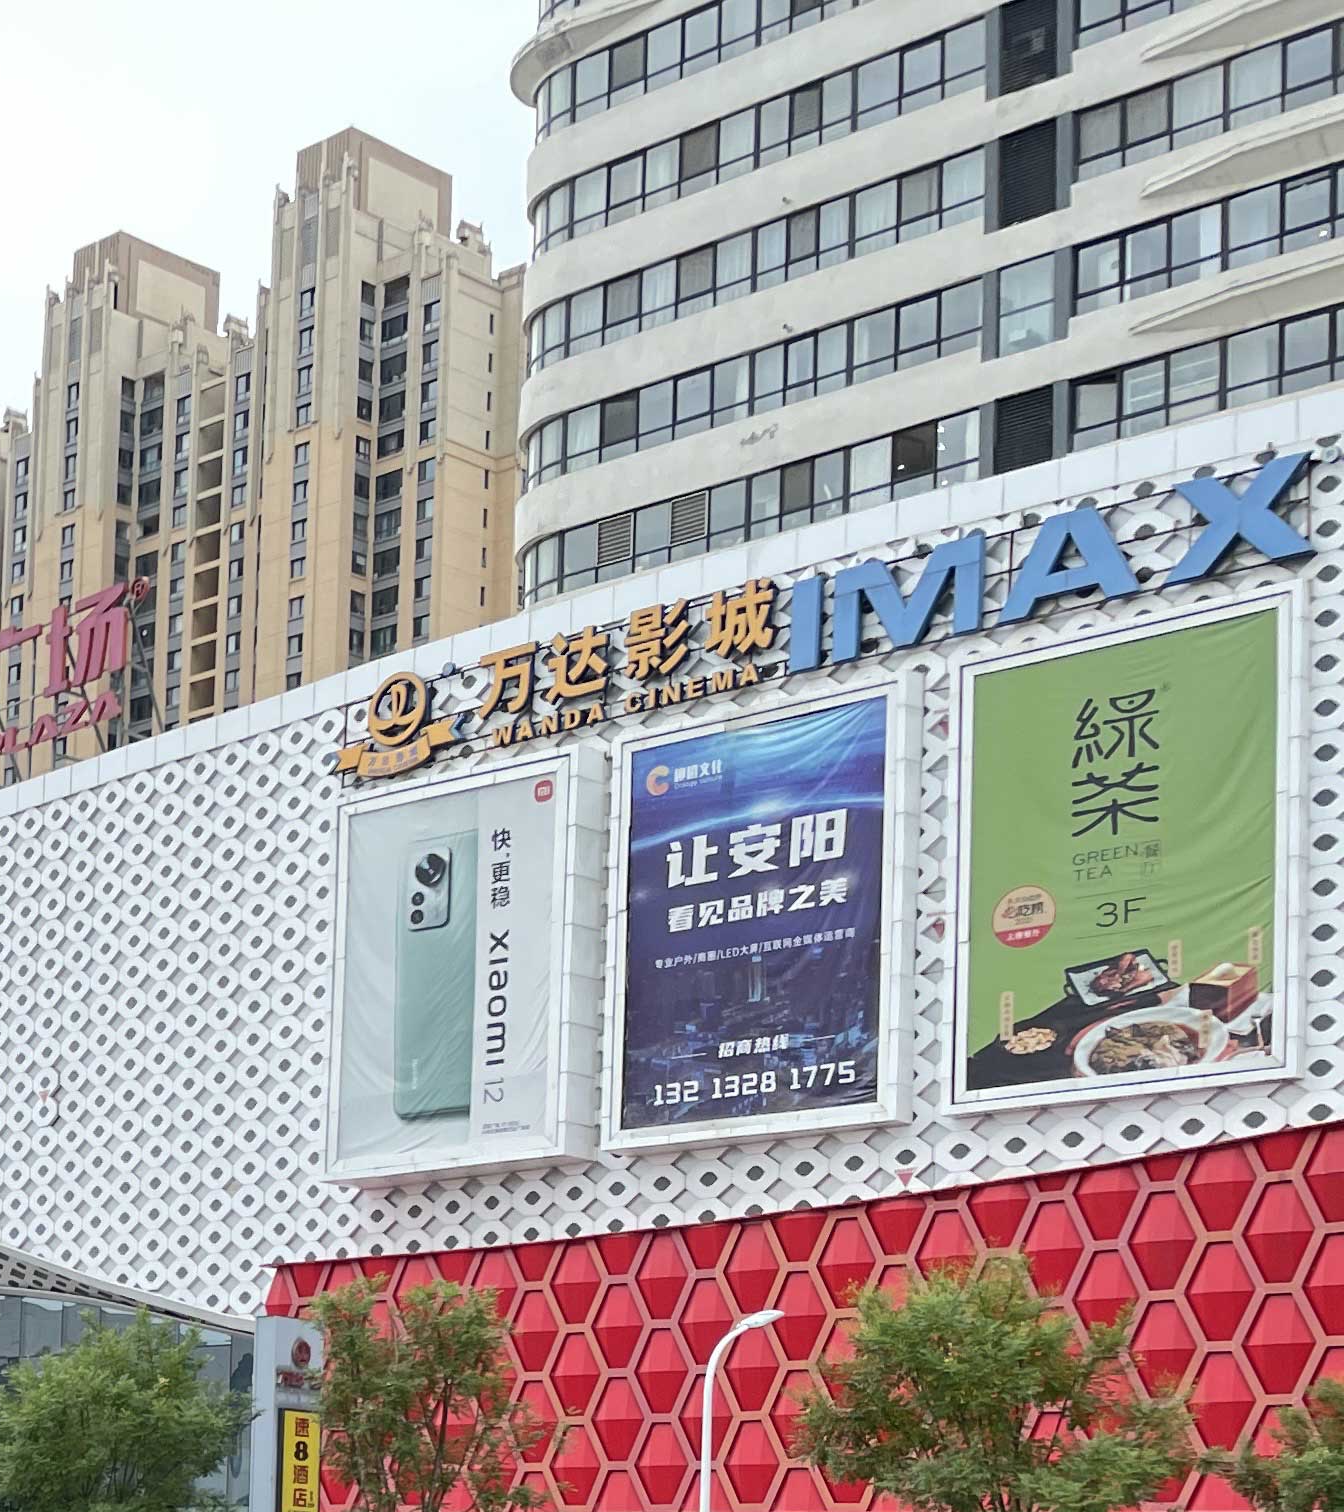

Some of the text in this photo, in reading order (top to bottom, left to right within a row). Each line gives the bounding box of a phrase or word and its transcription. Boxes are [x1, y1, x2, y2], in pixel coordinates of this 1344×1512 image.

[787, 450, 1313, 673] IMAX
[478, 579, 778, 720] 万达影城
[492, 663, 762, 747] WANDA CINEMA
[666, 808, 848, 889] 让安阳
[1072, 843, 1138, 866] GREEN
[1073, 865, 1113, 881] TEA
[668, 877, 848, 933] 看见品牌之美
[1096, 897, 1147, 927] 3F
[483, 1077, 504, 1104] 12
[653, 1061, 856, 1106] 132 1328 1775
